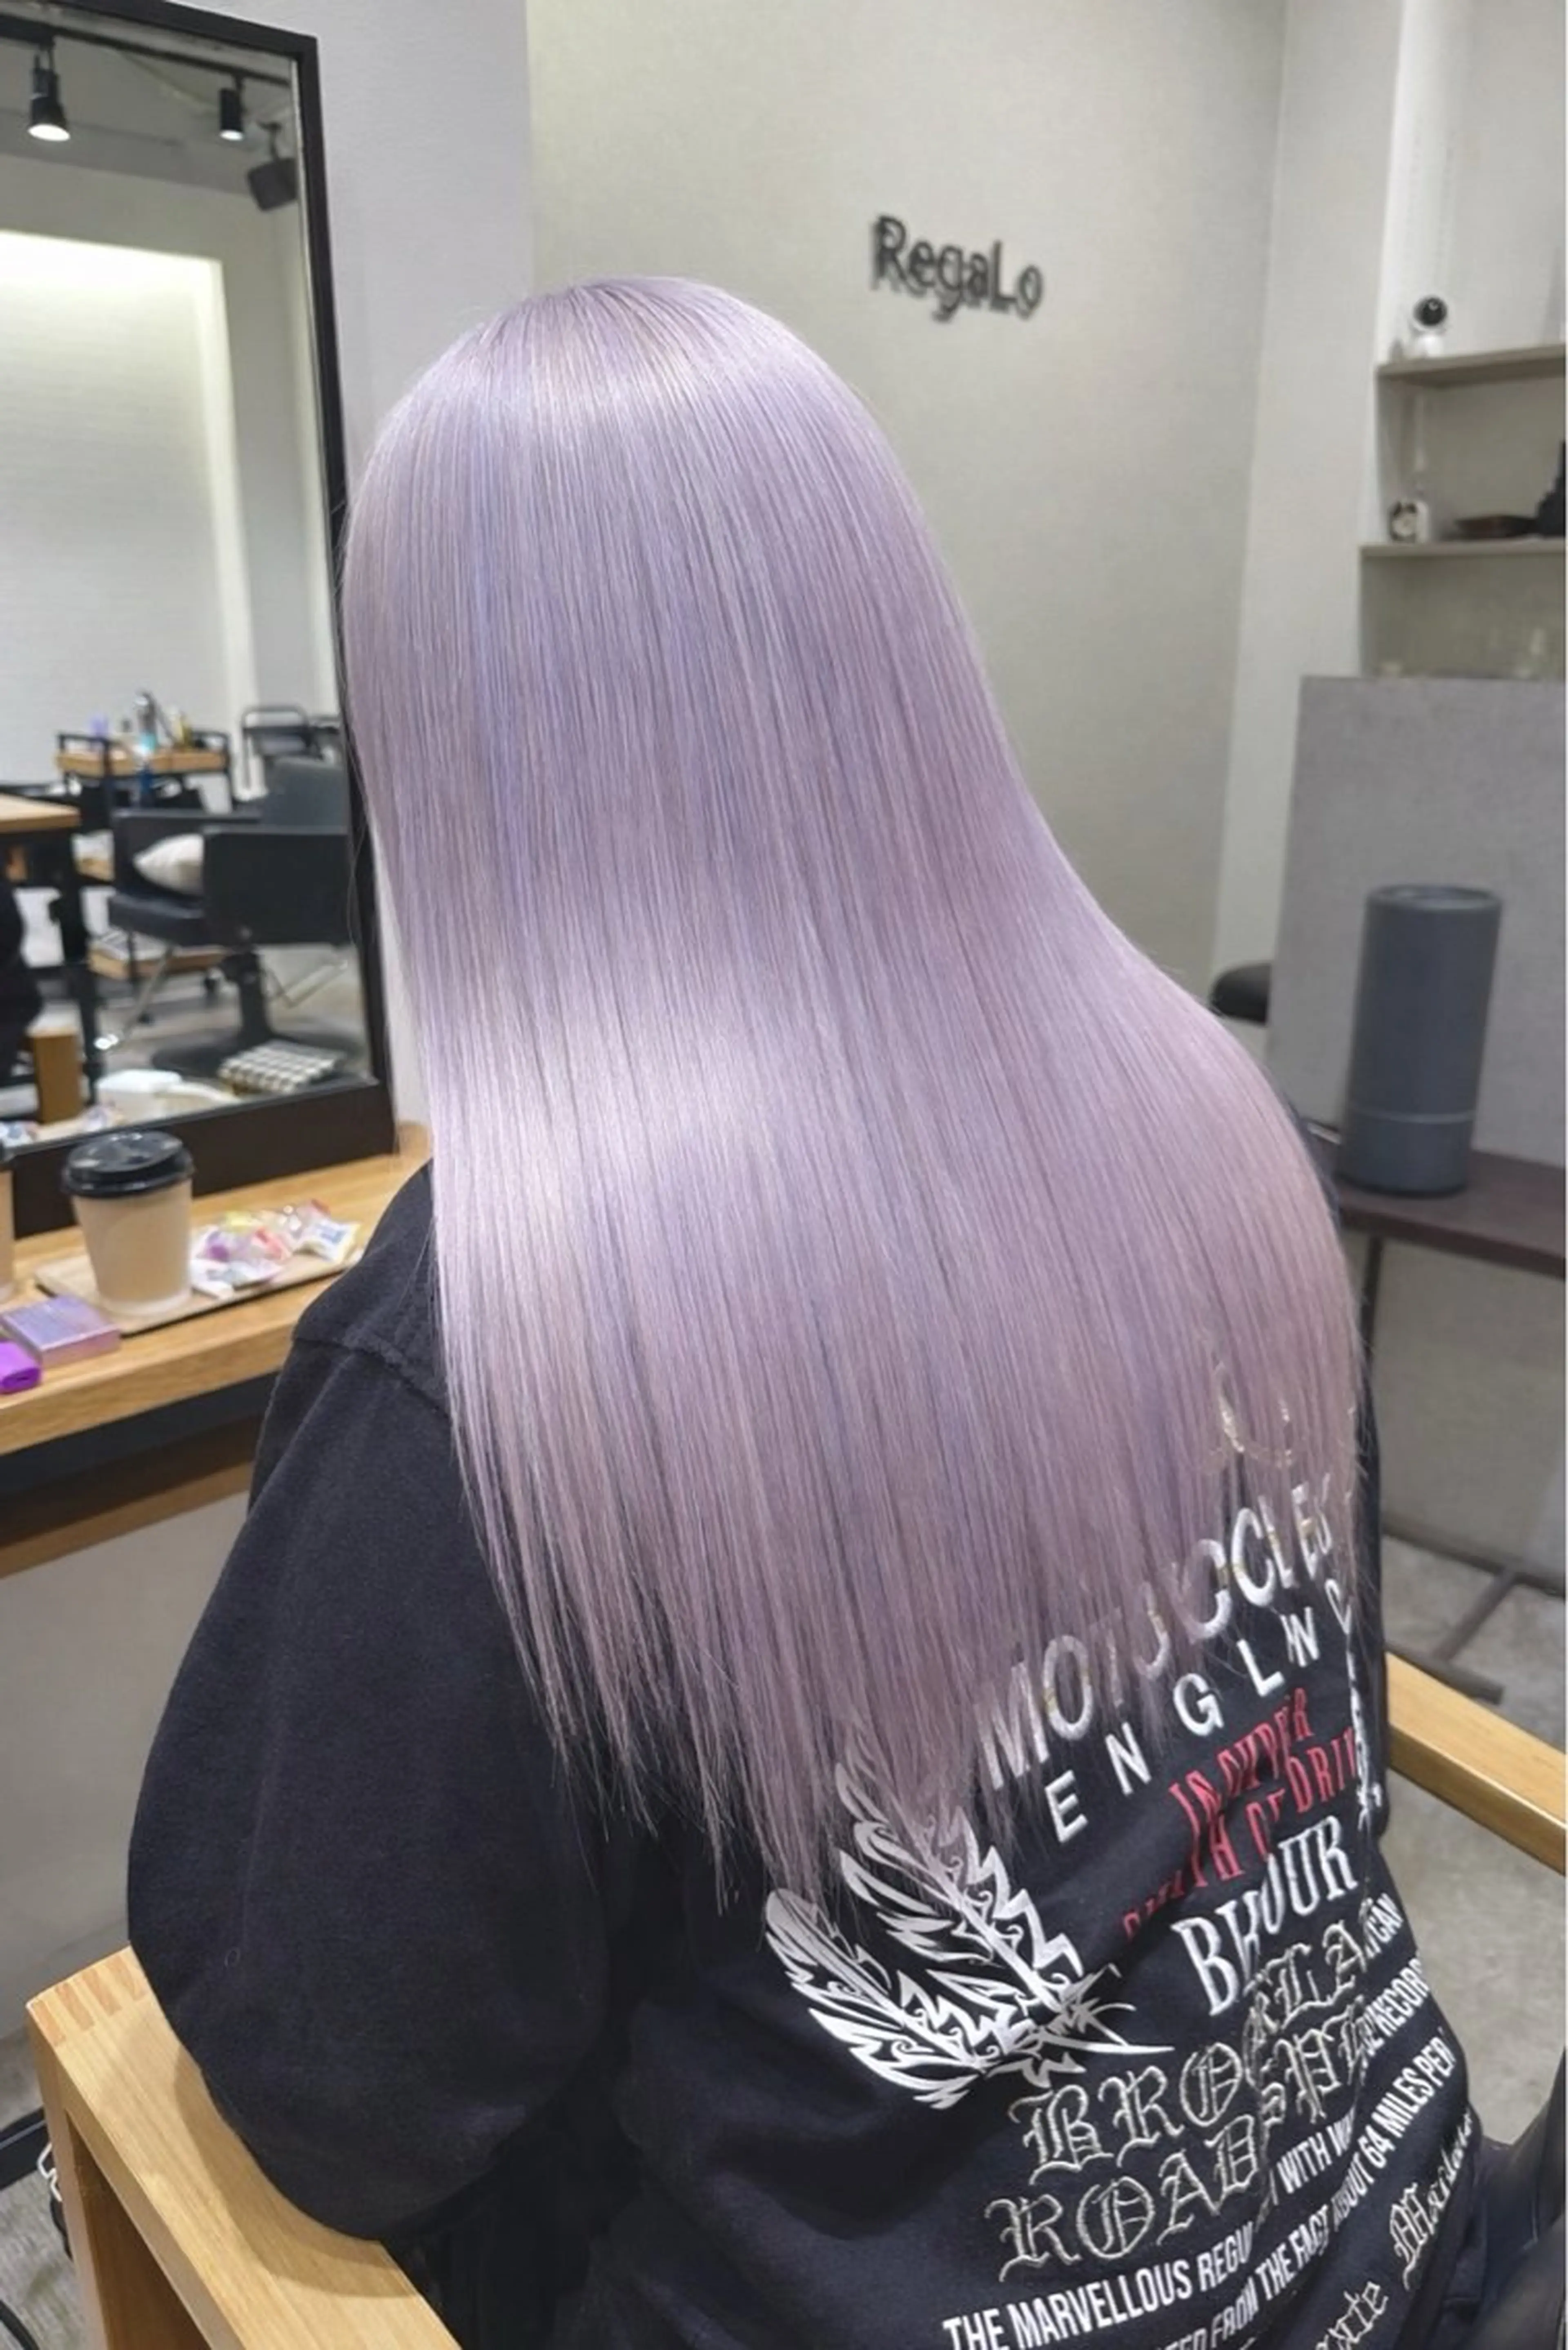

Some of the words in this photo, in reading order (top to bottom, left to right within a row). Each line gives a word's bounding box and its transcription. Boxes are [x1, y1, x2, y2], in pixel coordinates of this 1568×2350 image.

[1371, 2066, 1437, 2138] MILES
[1357, 2125, 1396, 2169] 64
[942, 2308, 1010, 2350] THE
[1007, 2259, 1192, 2349] MARVELLOUS
[1276, 2132, 1332, 2193] WITH
[1255, 2242, 1297, 2301] THE
